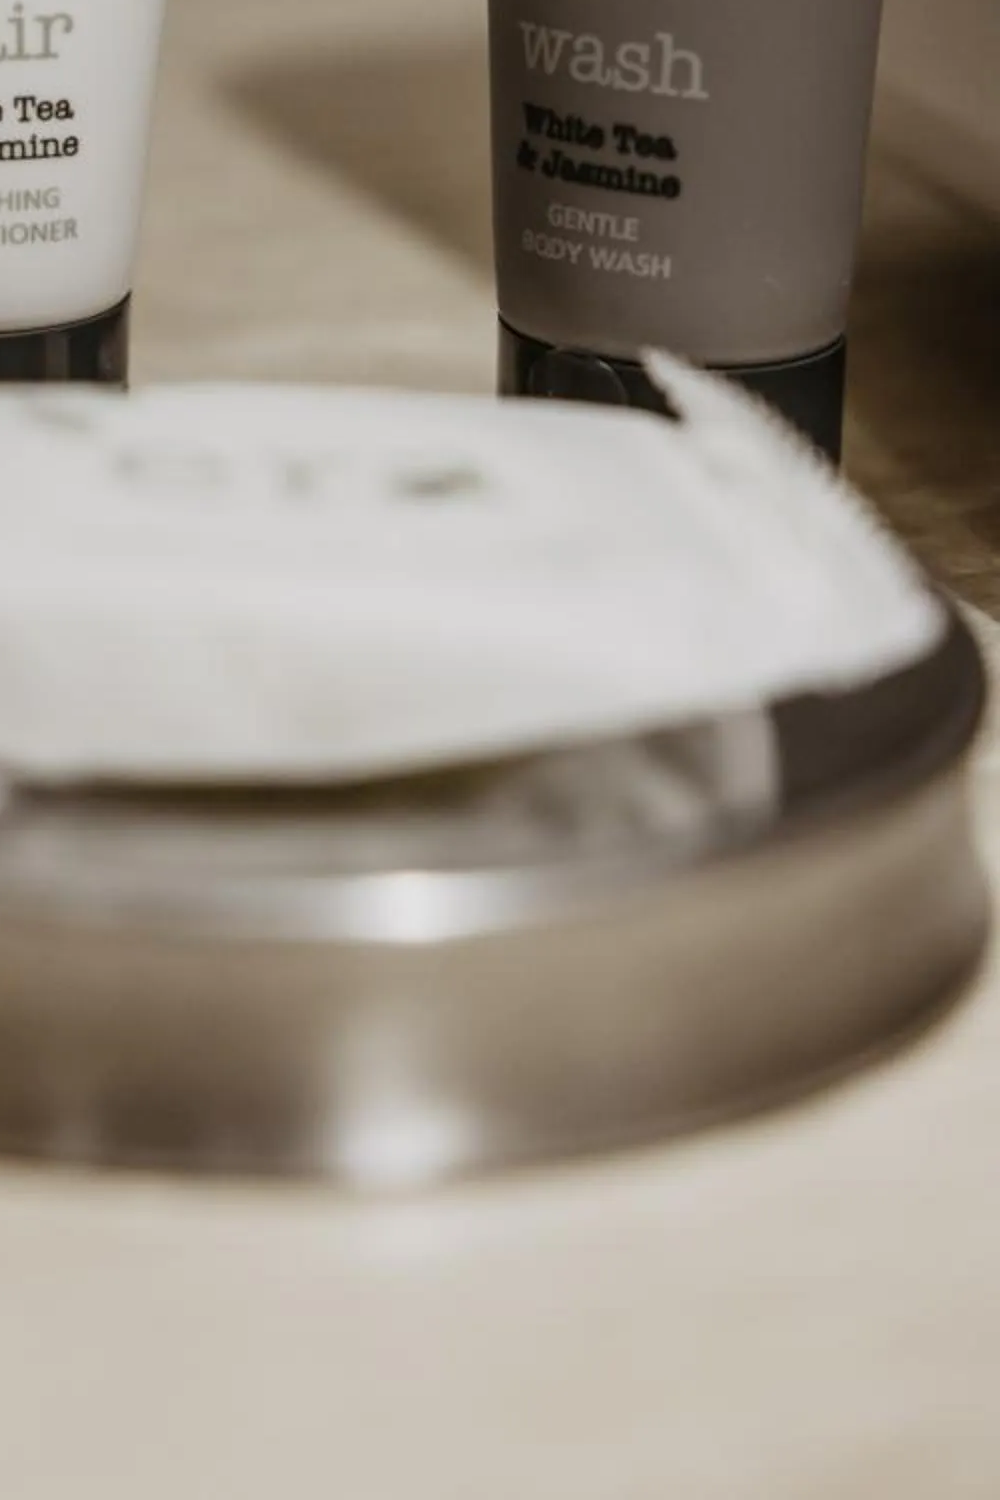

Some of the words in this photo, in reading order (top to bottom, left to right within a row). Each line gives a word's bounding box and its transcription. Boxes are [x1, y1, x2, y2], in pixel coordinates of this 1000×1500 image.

[518, 20, 710, 99] wash
[12, 95, 75, 122] Tea
[521, 102, 605, 150] White
[612, 123, 678, 162] Tea
[541, 150, 682, 200] Jasmine
[548, 203, 641, 241] GENTLE
[522, 228, 584, 265] BODY
[588, 245, 673, 279] WASH
